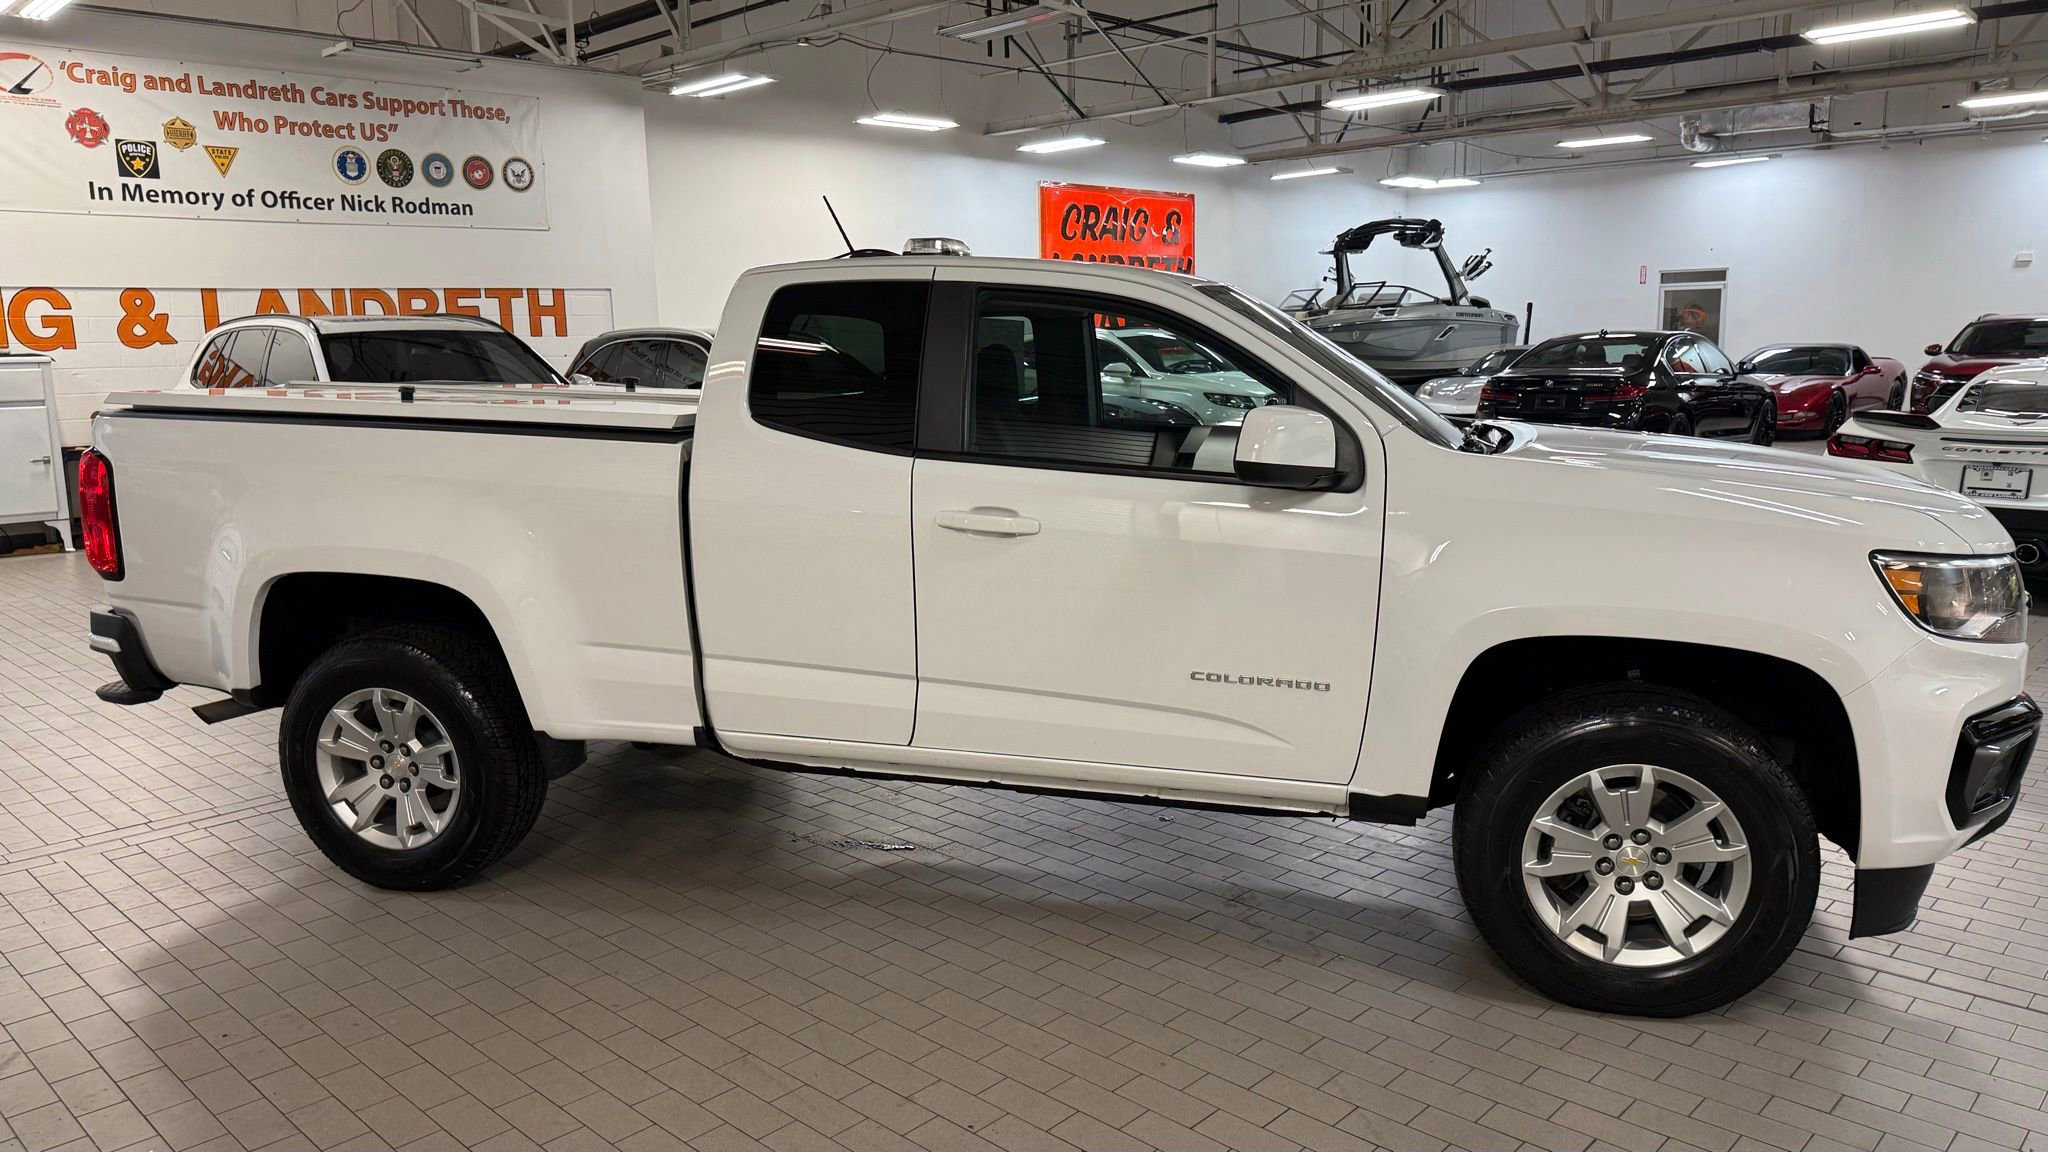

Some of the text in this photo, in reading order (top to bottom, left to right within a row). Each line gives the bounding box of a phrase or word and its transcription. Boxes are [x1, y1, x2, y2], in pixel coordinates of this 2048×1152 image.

[143, 73, 192, 93] and
[197, 75, 305, 104] Landreth
[310, 86, 358, 109] Cars
[362, 91, 446, 117] Support
[447, 99, 510, 124] Those,
[213, 110, 269, 134] Who
[274, 115, 356, 140] Protect
[121, 143, 152, 156] POLICE
[211, 148, 232, 156] STATE
[88, 181, 474, 216] In Memory of Officer Nick Rodman
[1061, 201, 1149, 243] CRAIG
[117, 287, 178, 349] &
[1190, 671, 1331, 691] COLORADO
